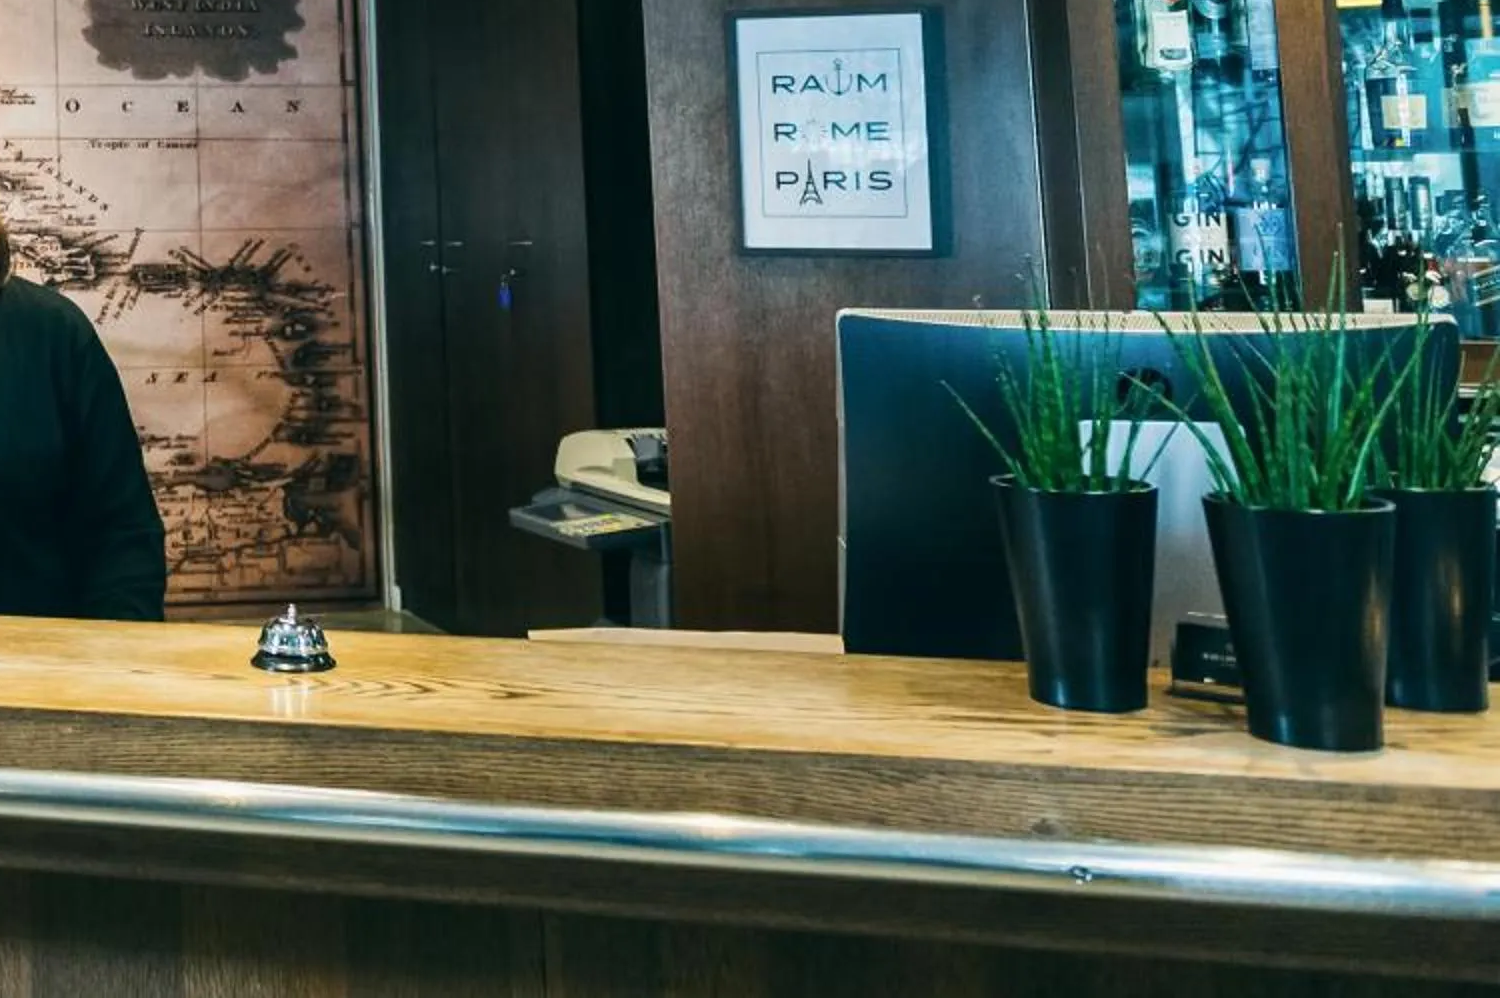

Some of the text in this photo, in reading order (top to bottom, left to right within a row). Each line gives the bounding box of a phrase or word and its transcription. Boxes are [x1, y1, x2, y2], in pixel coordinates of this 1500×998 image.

[142, 24, 248, 37] ISLANDS
[771, 59, 888, 97] RAUM
[65, 97, 301, 114] OCEAN
[773, 121, 891, 142] RME
[775, 158, 894, 205] PARIS
[1173, 211, 1222, 227] GIN
[1175, 248, 1225, 264] GIN
